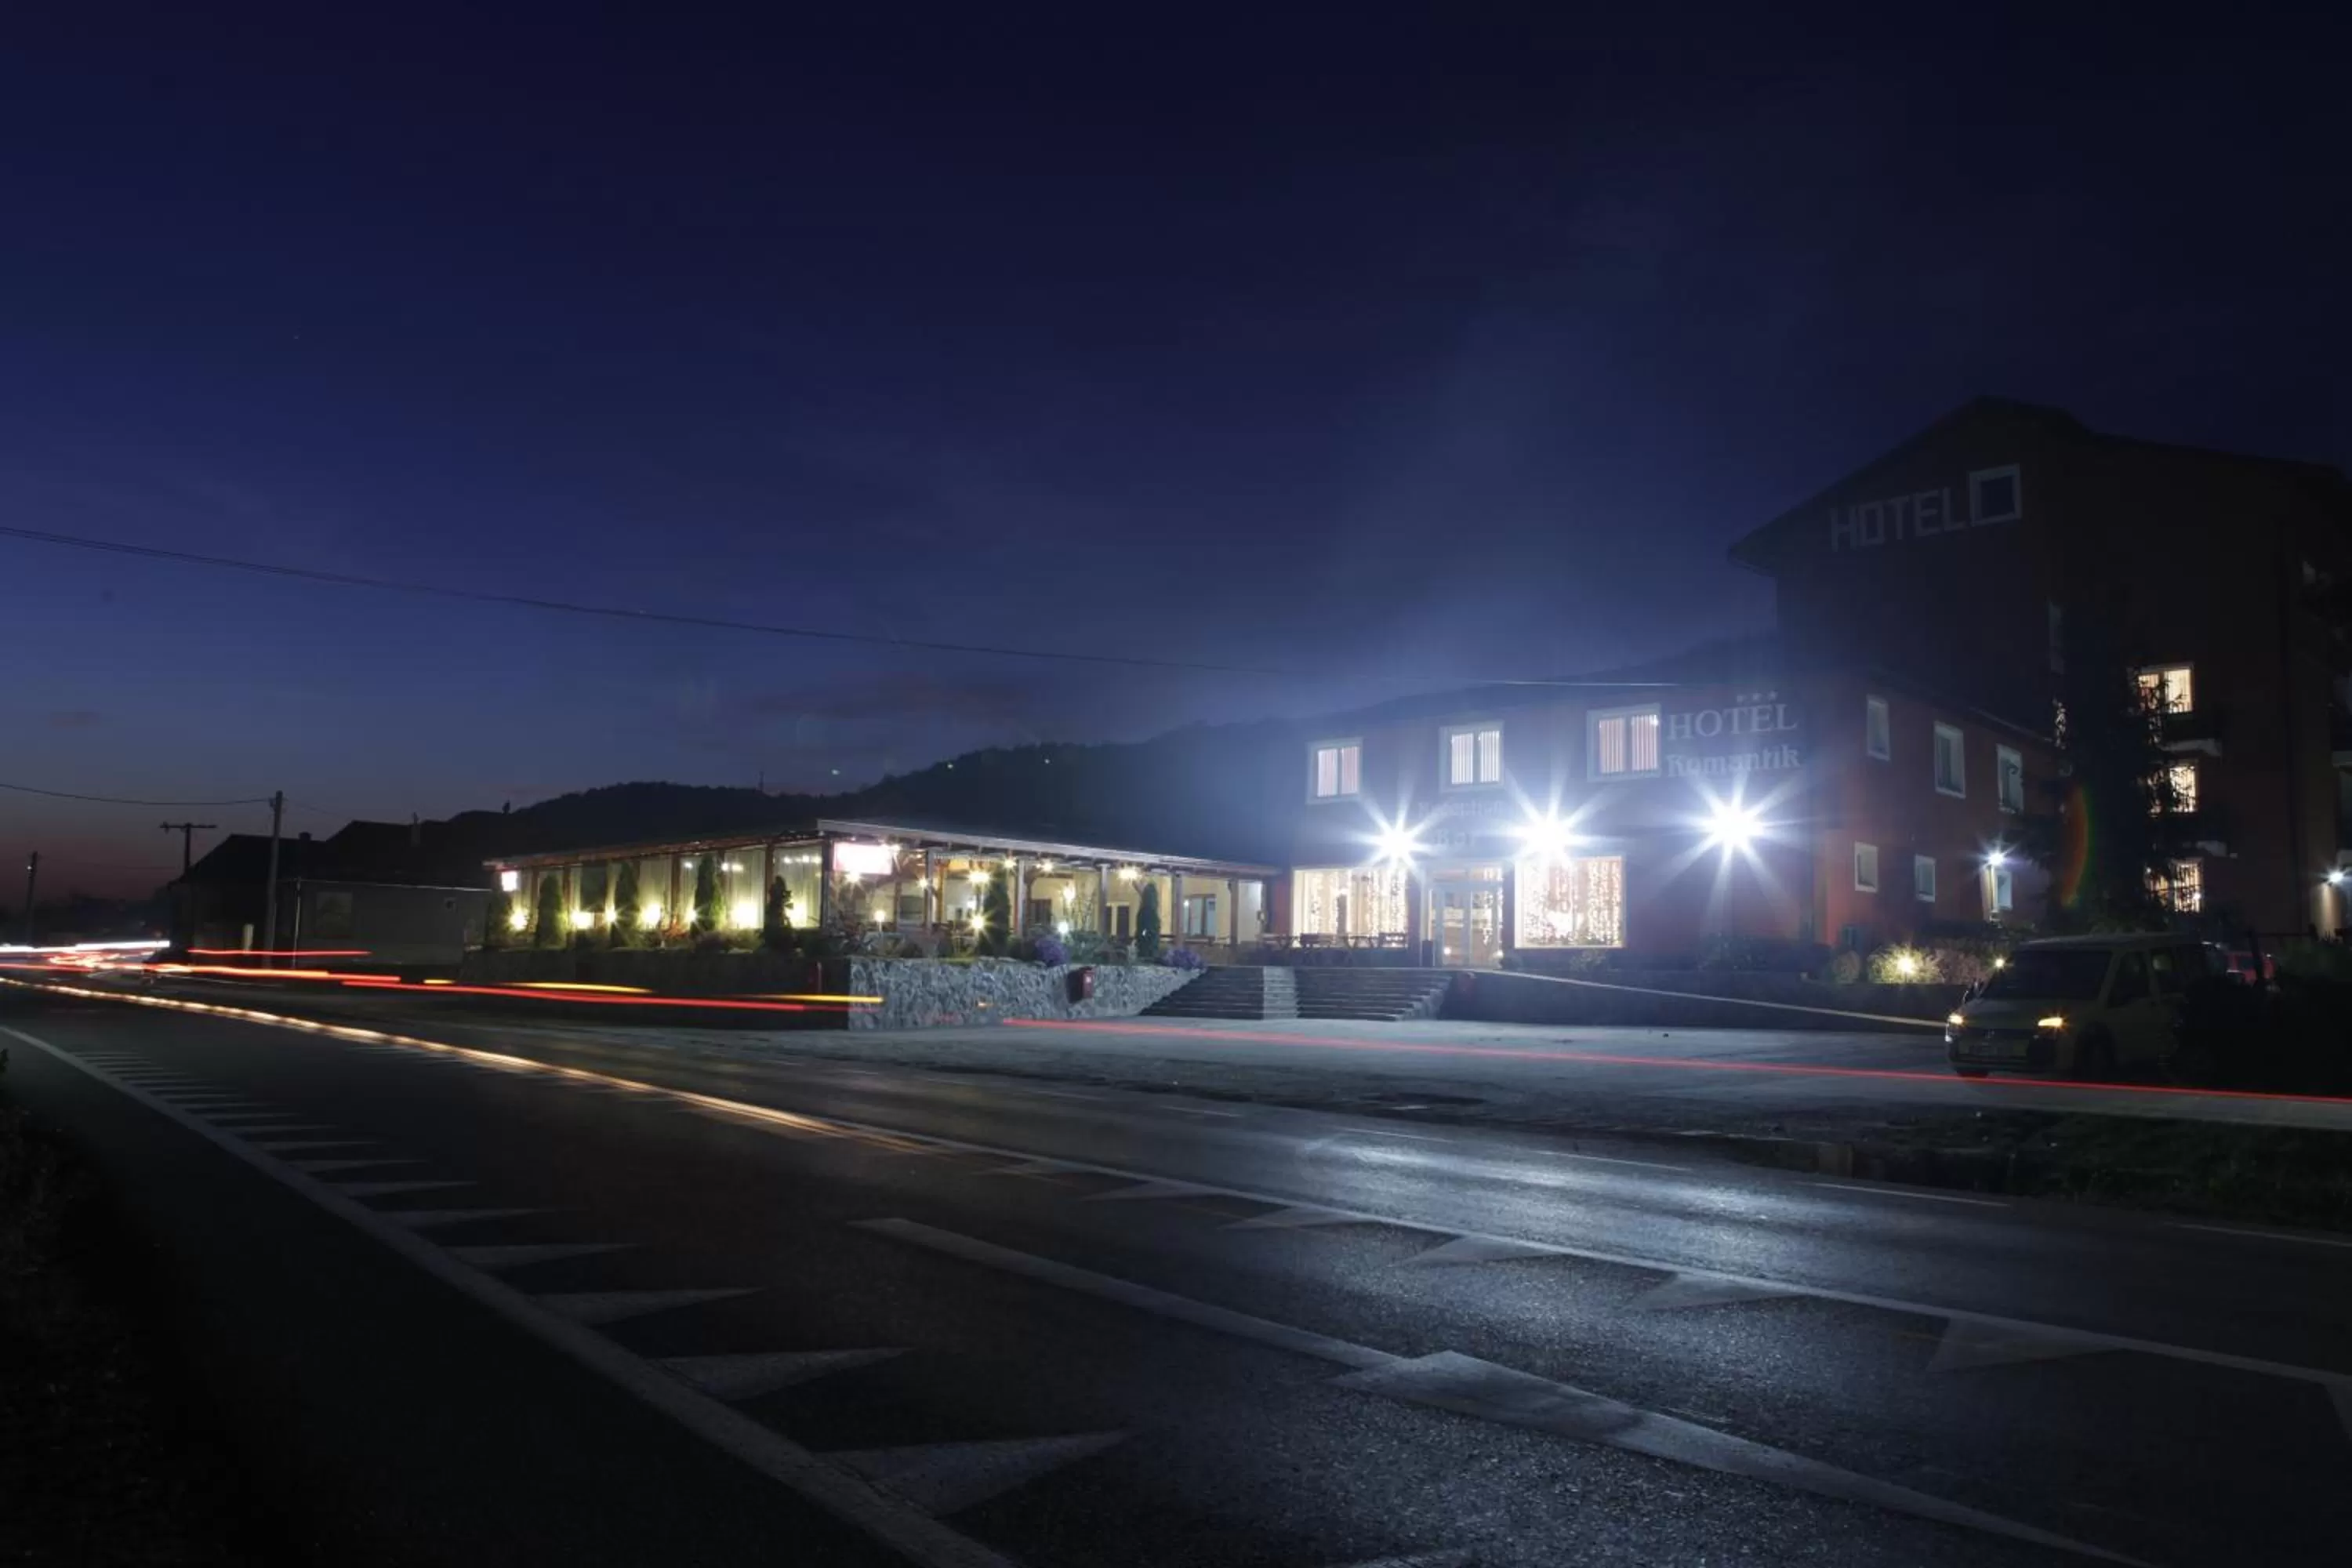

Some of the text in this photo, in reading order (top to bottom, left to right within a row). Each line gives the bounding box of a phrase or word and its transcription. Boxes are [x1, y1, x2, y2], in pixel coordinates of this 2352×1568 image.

[1829, 485, 1967, 553] HOTEL
[1667, 703, 1798, 741] HOTEL
[1665, 743, 1801, 777] Romantik
